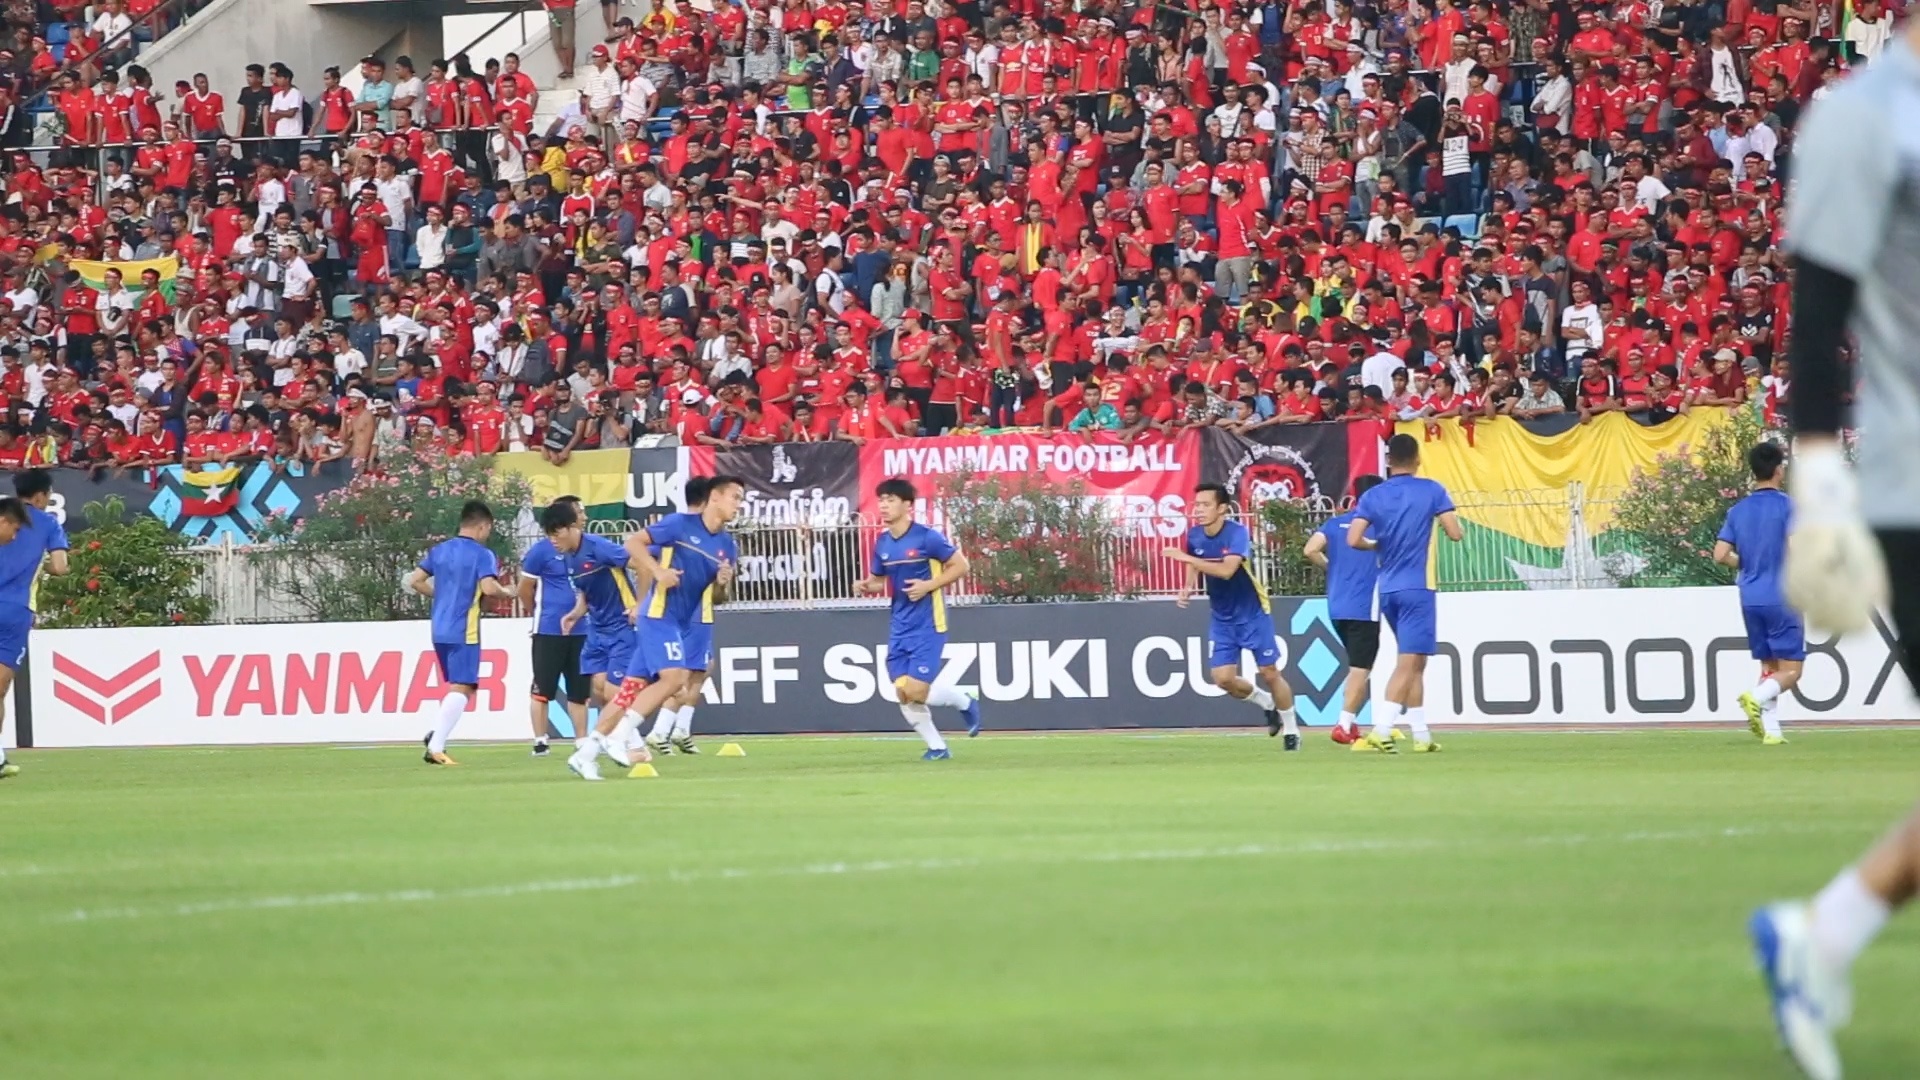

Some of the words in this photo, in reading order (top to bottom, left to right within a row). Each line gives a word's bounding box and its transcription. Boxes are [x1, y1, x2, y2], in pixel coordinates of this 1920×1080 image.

[884, 447, 1029, 476] MYANMAR
[1037, 444, 1182, 472] FOOTBALL
[664, 642, 682, 660] 15
[182, 649, 508, 717] YANMAR
[700, 645, 798, 705] FF
